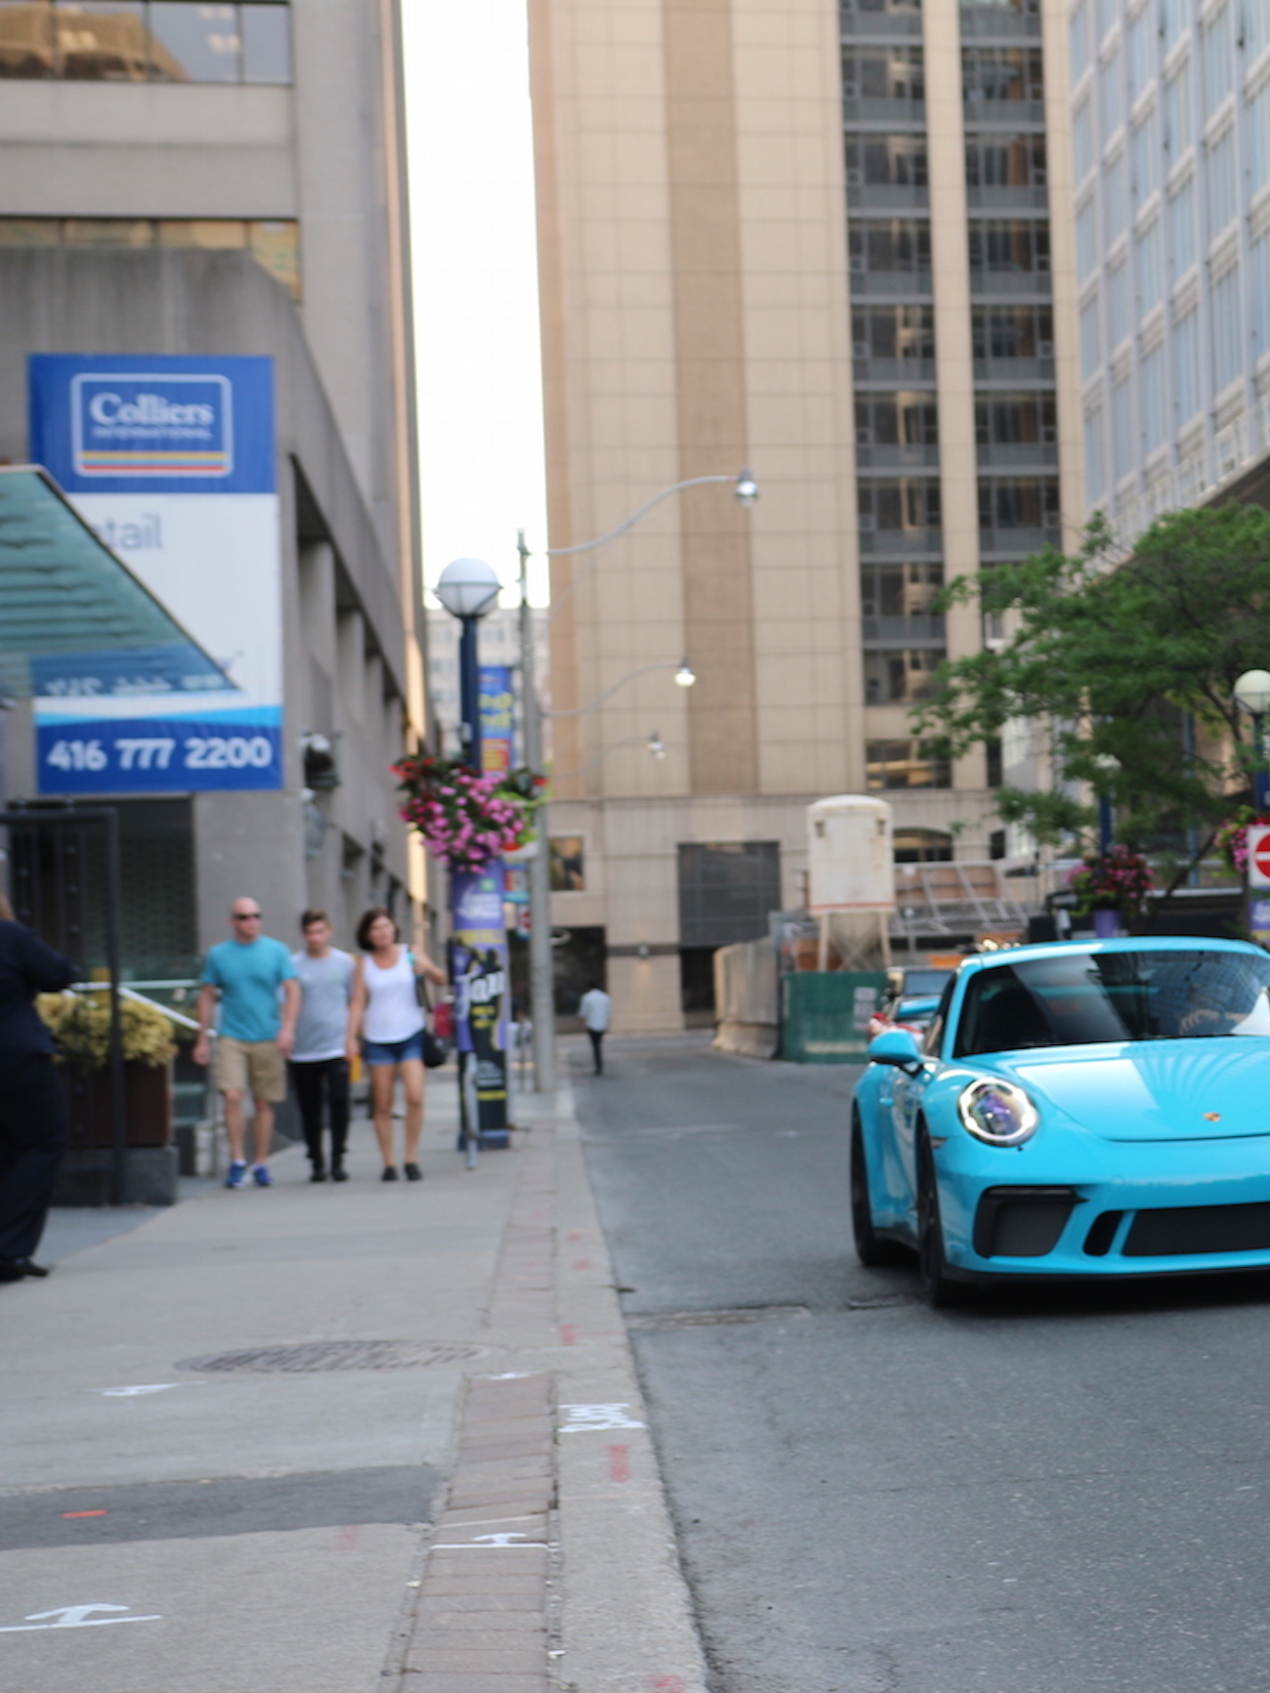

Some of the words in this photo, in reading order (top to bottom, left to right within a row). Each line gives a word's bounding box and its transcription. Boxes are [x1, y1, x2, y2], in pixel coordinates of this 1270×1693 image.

[89, 391, 214, 426] Colliers
[47, 740, 107, 770] 416
[115, 738, 175, 769] 777
[185, 736, 272, 769] 2200
